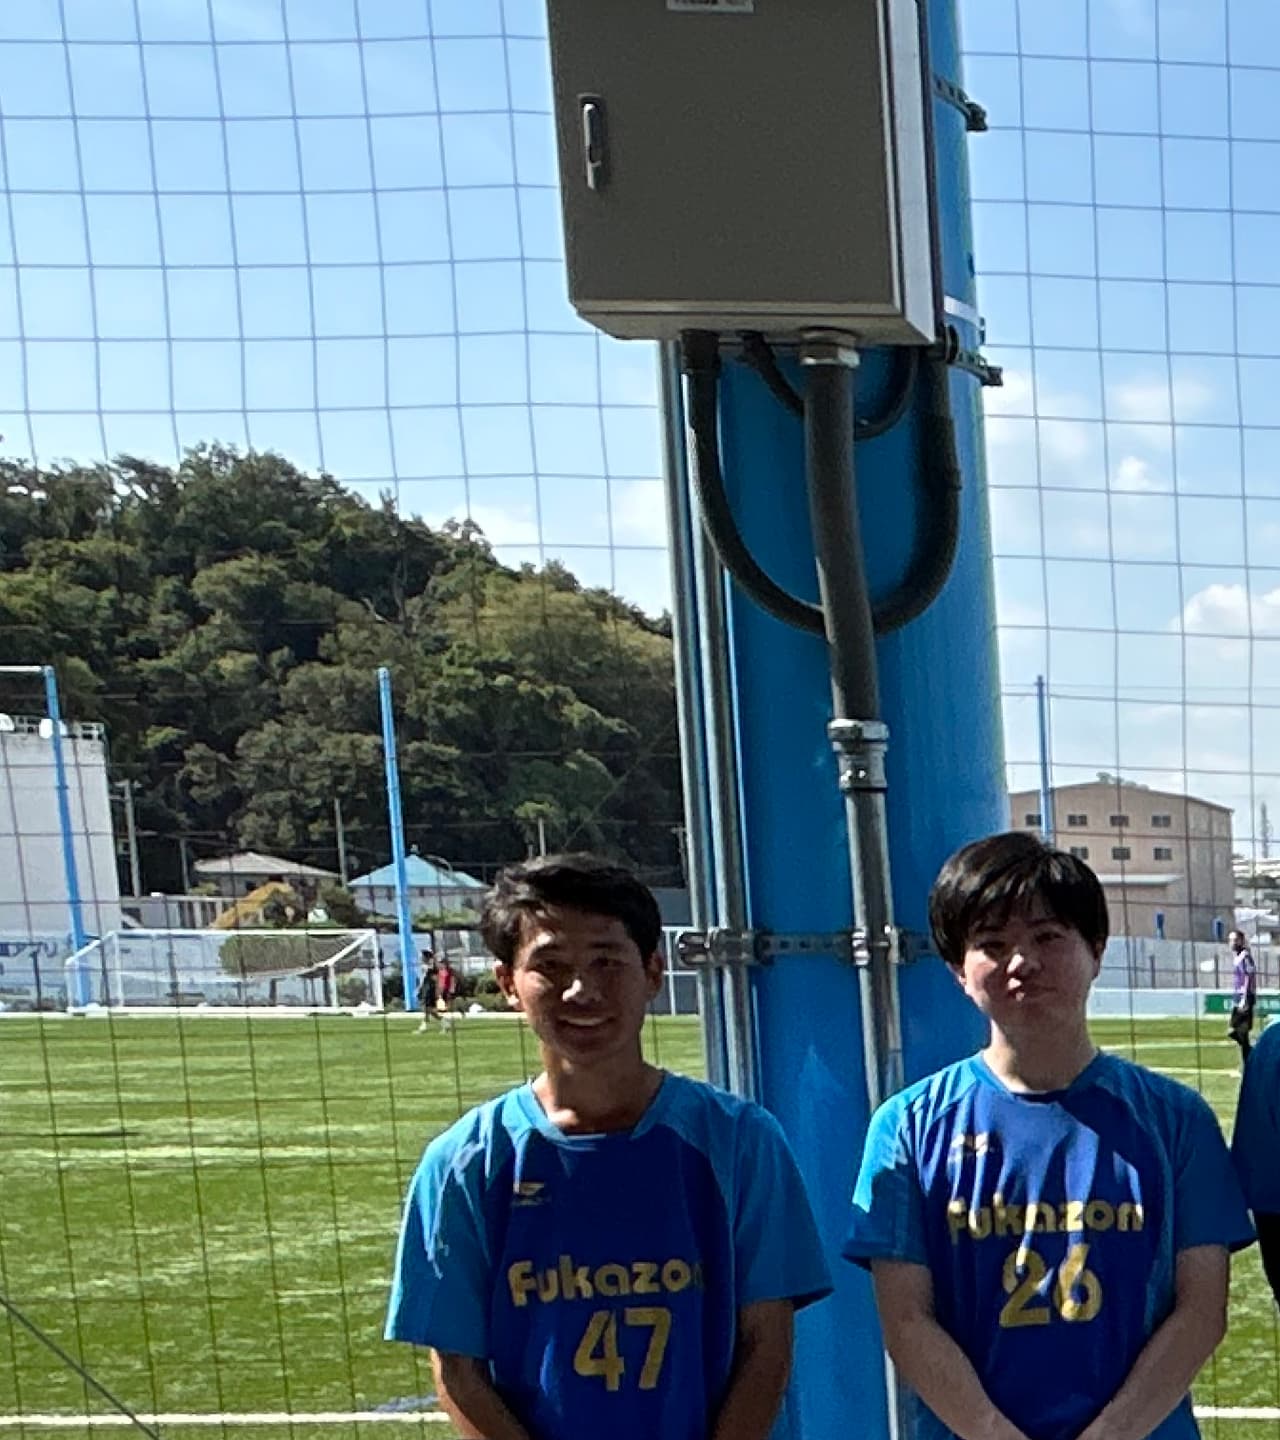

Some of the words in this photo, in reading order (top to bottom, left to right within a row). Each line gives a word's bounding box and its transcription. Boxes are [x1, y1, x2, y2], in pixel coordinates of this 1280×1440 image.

[507, 1254, 703, 1307] Fukazo
[1000, 1243, 1103, 1329] 26
[573, 1306, 673, 1392] 47
